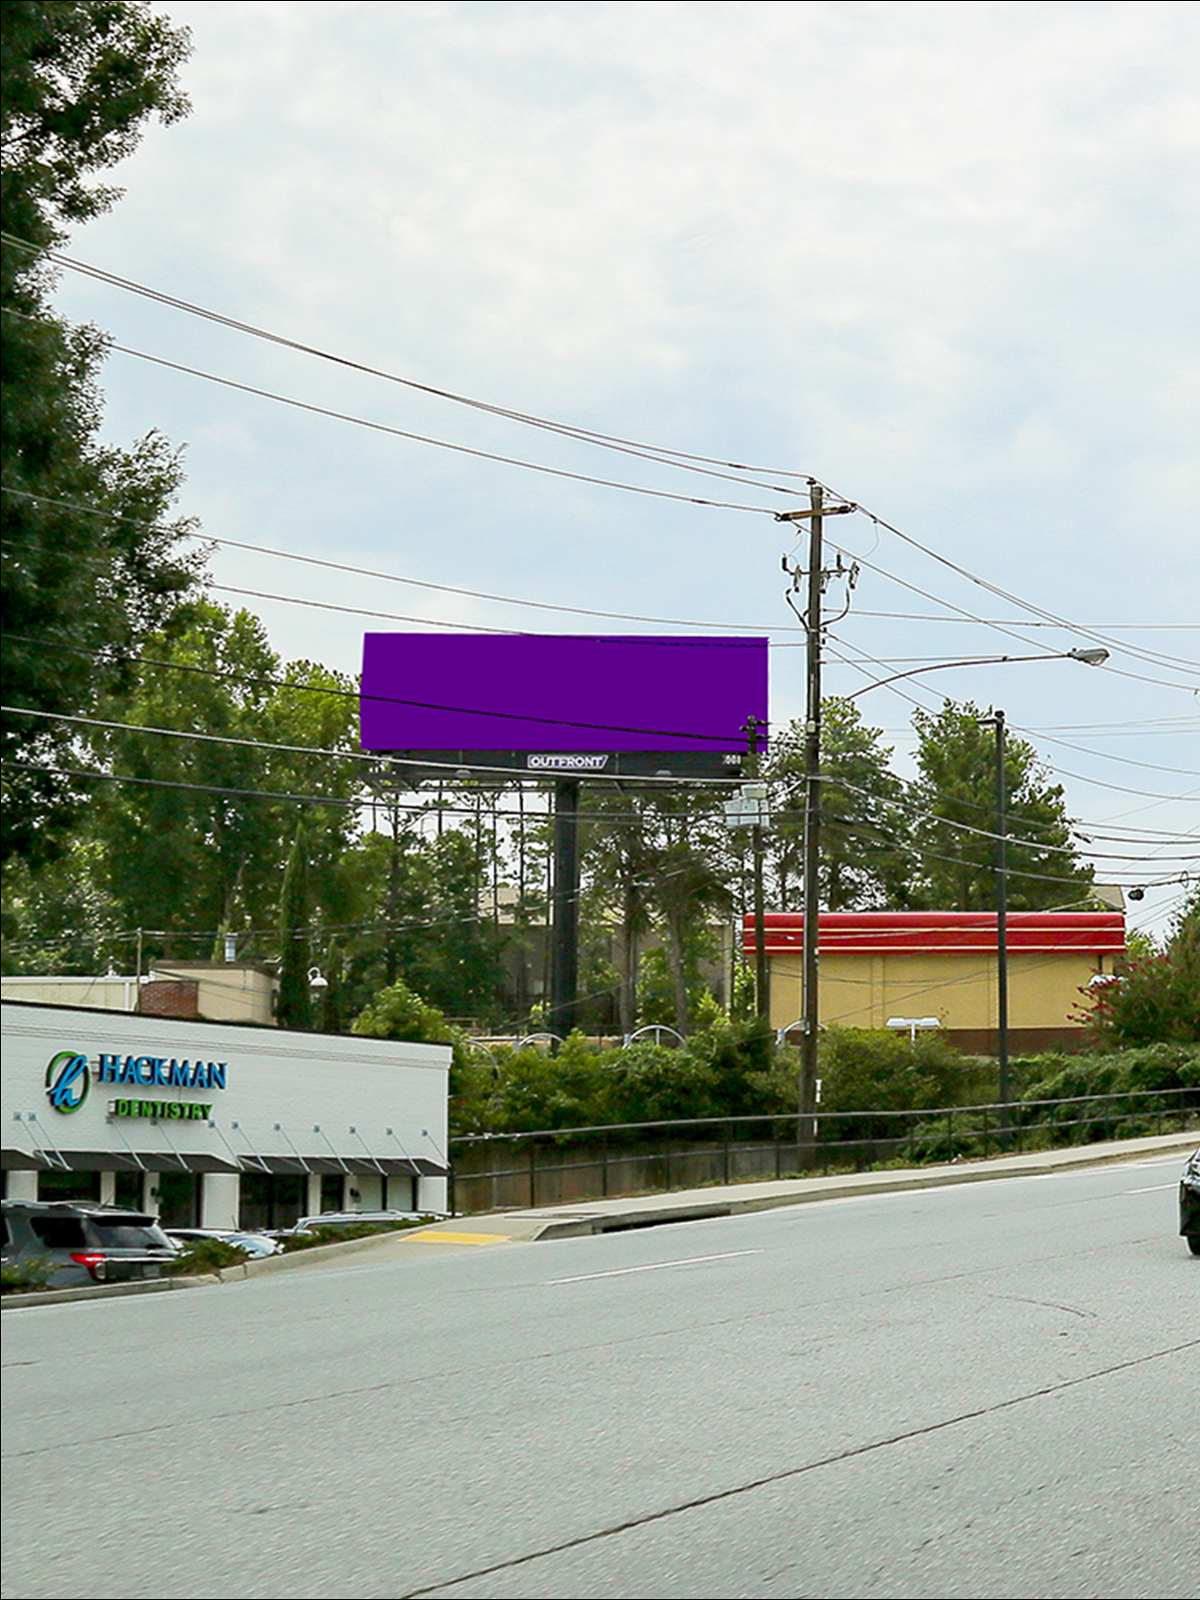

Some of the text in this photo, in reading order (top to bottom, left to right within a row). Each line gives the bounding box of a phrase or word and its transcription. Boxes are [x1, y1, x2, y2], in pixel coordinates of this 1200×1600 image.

[530, 756, 603, 767] OUTFRONT
[98, 1053, 228, 1090] HACKMAN
[114, 1099, 213, 1121] DENTISTRY
